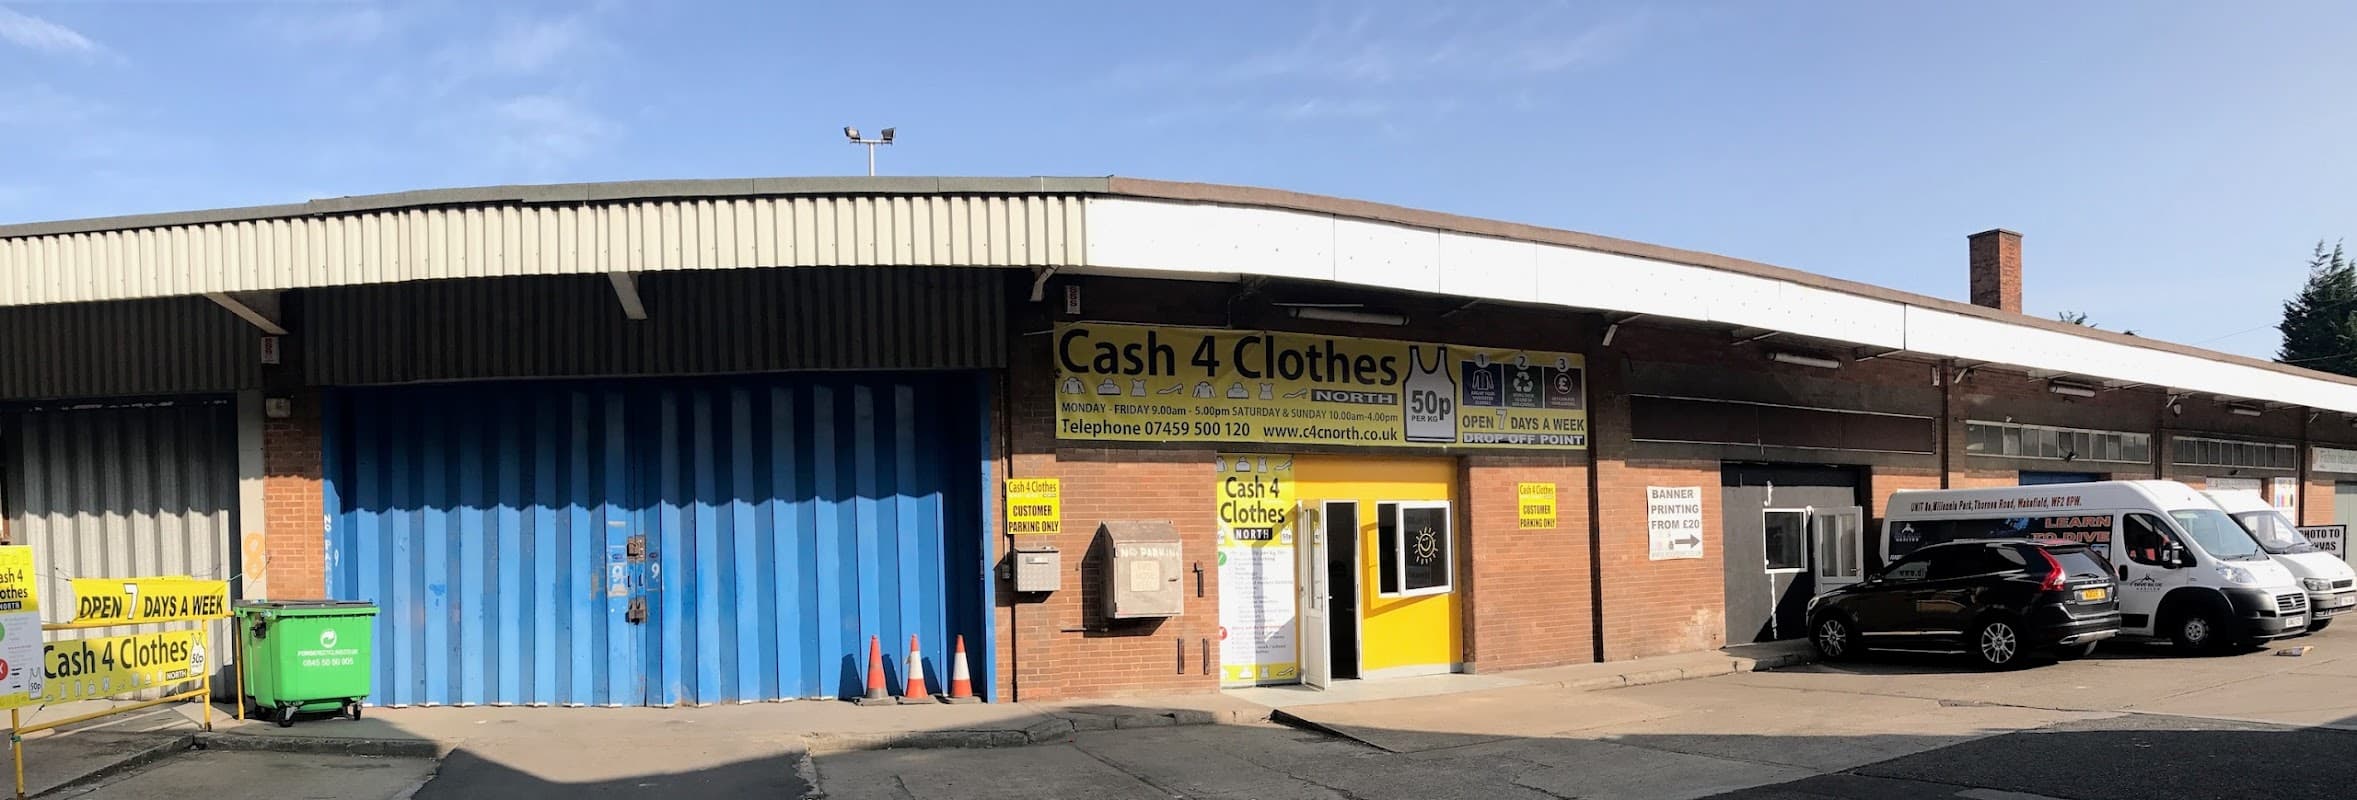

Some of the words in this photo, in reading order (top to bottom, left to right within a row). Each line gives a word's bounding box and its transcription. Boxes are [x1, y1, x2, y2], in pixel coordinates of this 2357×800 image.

[1059, 328, 1175, 376] Cash
[1191, 335, 1220, 377] 4
[1233, 335, 1398, 386] Clothes
[1479, 354, 1485, 365] 1
[1519, 356, 1526, 367] 2
[1559, 358, 1566, 369] 3
[1315, 391, 1393, 403] NORTH
[1411, 390, 1450, 420] 50p
[1061, 402, 1106, 413] MONDAY
[1114, 404, 1149, 415] FRIDAY
[1152, 405, 1186, 415] 9.00am
[1195, 406, 1230, 417] 5.00pm
[1232, 407, 1280, 417] SATURDAY
[1282, 408, 1289, 417] &
[1291, 409, 1327, 419] SUNDAY
[1329, 411, 1398, 423] 10.00am-4.00pm
[1462, 415, 1494, 429] OPEN
[1496, 408, 1507, 430] 7
[1511, 417, 1539, 430] DAYS
[1543, 418, 1550, 430] A
[1553, 418, 1584, 431] WEEK
[1061, 419, 1140, 437] Telephone
[1145, 421, 1189, 435] 07459
[1194, 422, 1220, 435] 500
[1225, 422, 1250, 436] 120
[1264, 425, 1397, 441] www.c4cnorth.co.uk
[1463, 434, 1504, 443] DROP
[1509, 434, 1535, 444] OFF
[1540, 435, 1584, 445] POINT
[1008, 480, 1024, 493] Cash
[1026, 481, 1031, 492] 4
[1031, 480, 1057, 493] Clothes
[1225, 475, 1265, 498] Cash
[1270, 477, 1280, 498] 4
[1652, 489, 1694, 499] BANNER
[1013, 504, 1052, 516] CUSTOMER
[1220, 500, 1285, 523] Clothes
[1523, 504, 1551, 514] CUSTOMER
[1651, 504, 1699, 514] PRINTING
[324, 513, 332, 533] NO
[1008, 521, 1040, 533] PARKING
[1042, 520, 1059, 532] ONLY
[1520, 518, 1543, 528] PARKING
[1651, 520, 1680, 529] FROM
[1682, 519, 1700, 529] £20
[2045, 516, 2111, 528] LEARN
[1235, 528, 1270, 539] NORTH
[2031, 532, 2058, 541] TO
[2063, 531, 2111, 542] DIVE
[2330, 529, 2340, 538] TO
[2311, 541, 2336, 551] NVAS
[0, 568, 15, 583] ash
[17, 569, 23, 583] 4
[0, 584, 28, 599] othes
[79, 595, 122, 619] OPEN
[123, 583, 139, 619] 7
[144, 595, 177, 618] DAYS
[180, 595, 188, 616] A
[192, 595, 223, 616] WEEK
[44, 641, 95, 679] Cash
[102, 641, 114, 672] 4
[120, 634, 188, 669] Clothes
[166, 669, 187, 681] NORTH
[30, 682, 41, 692] 50p
